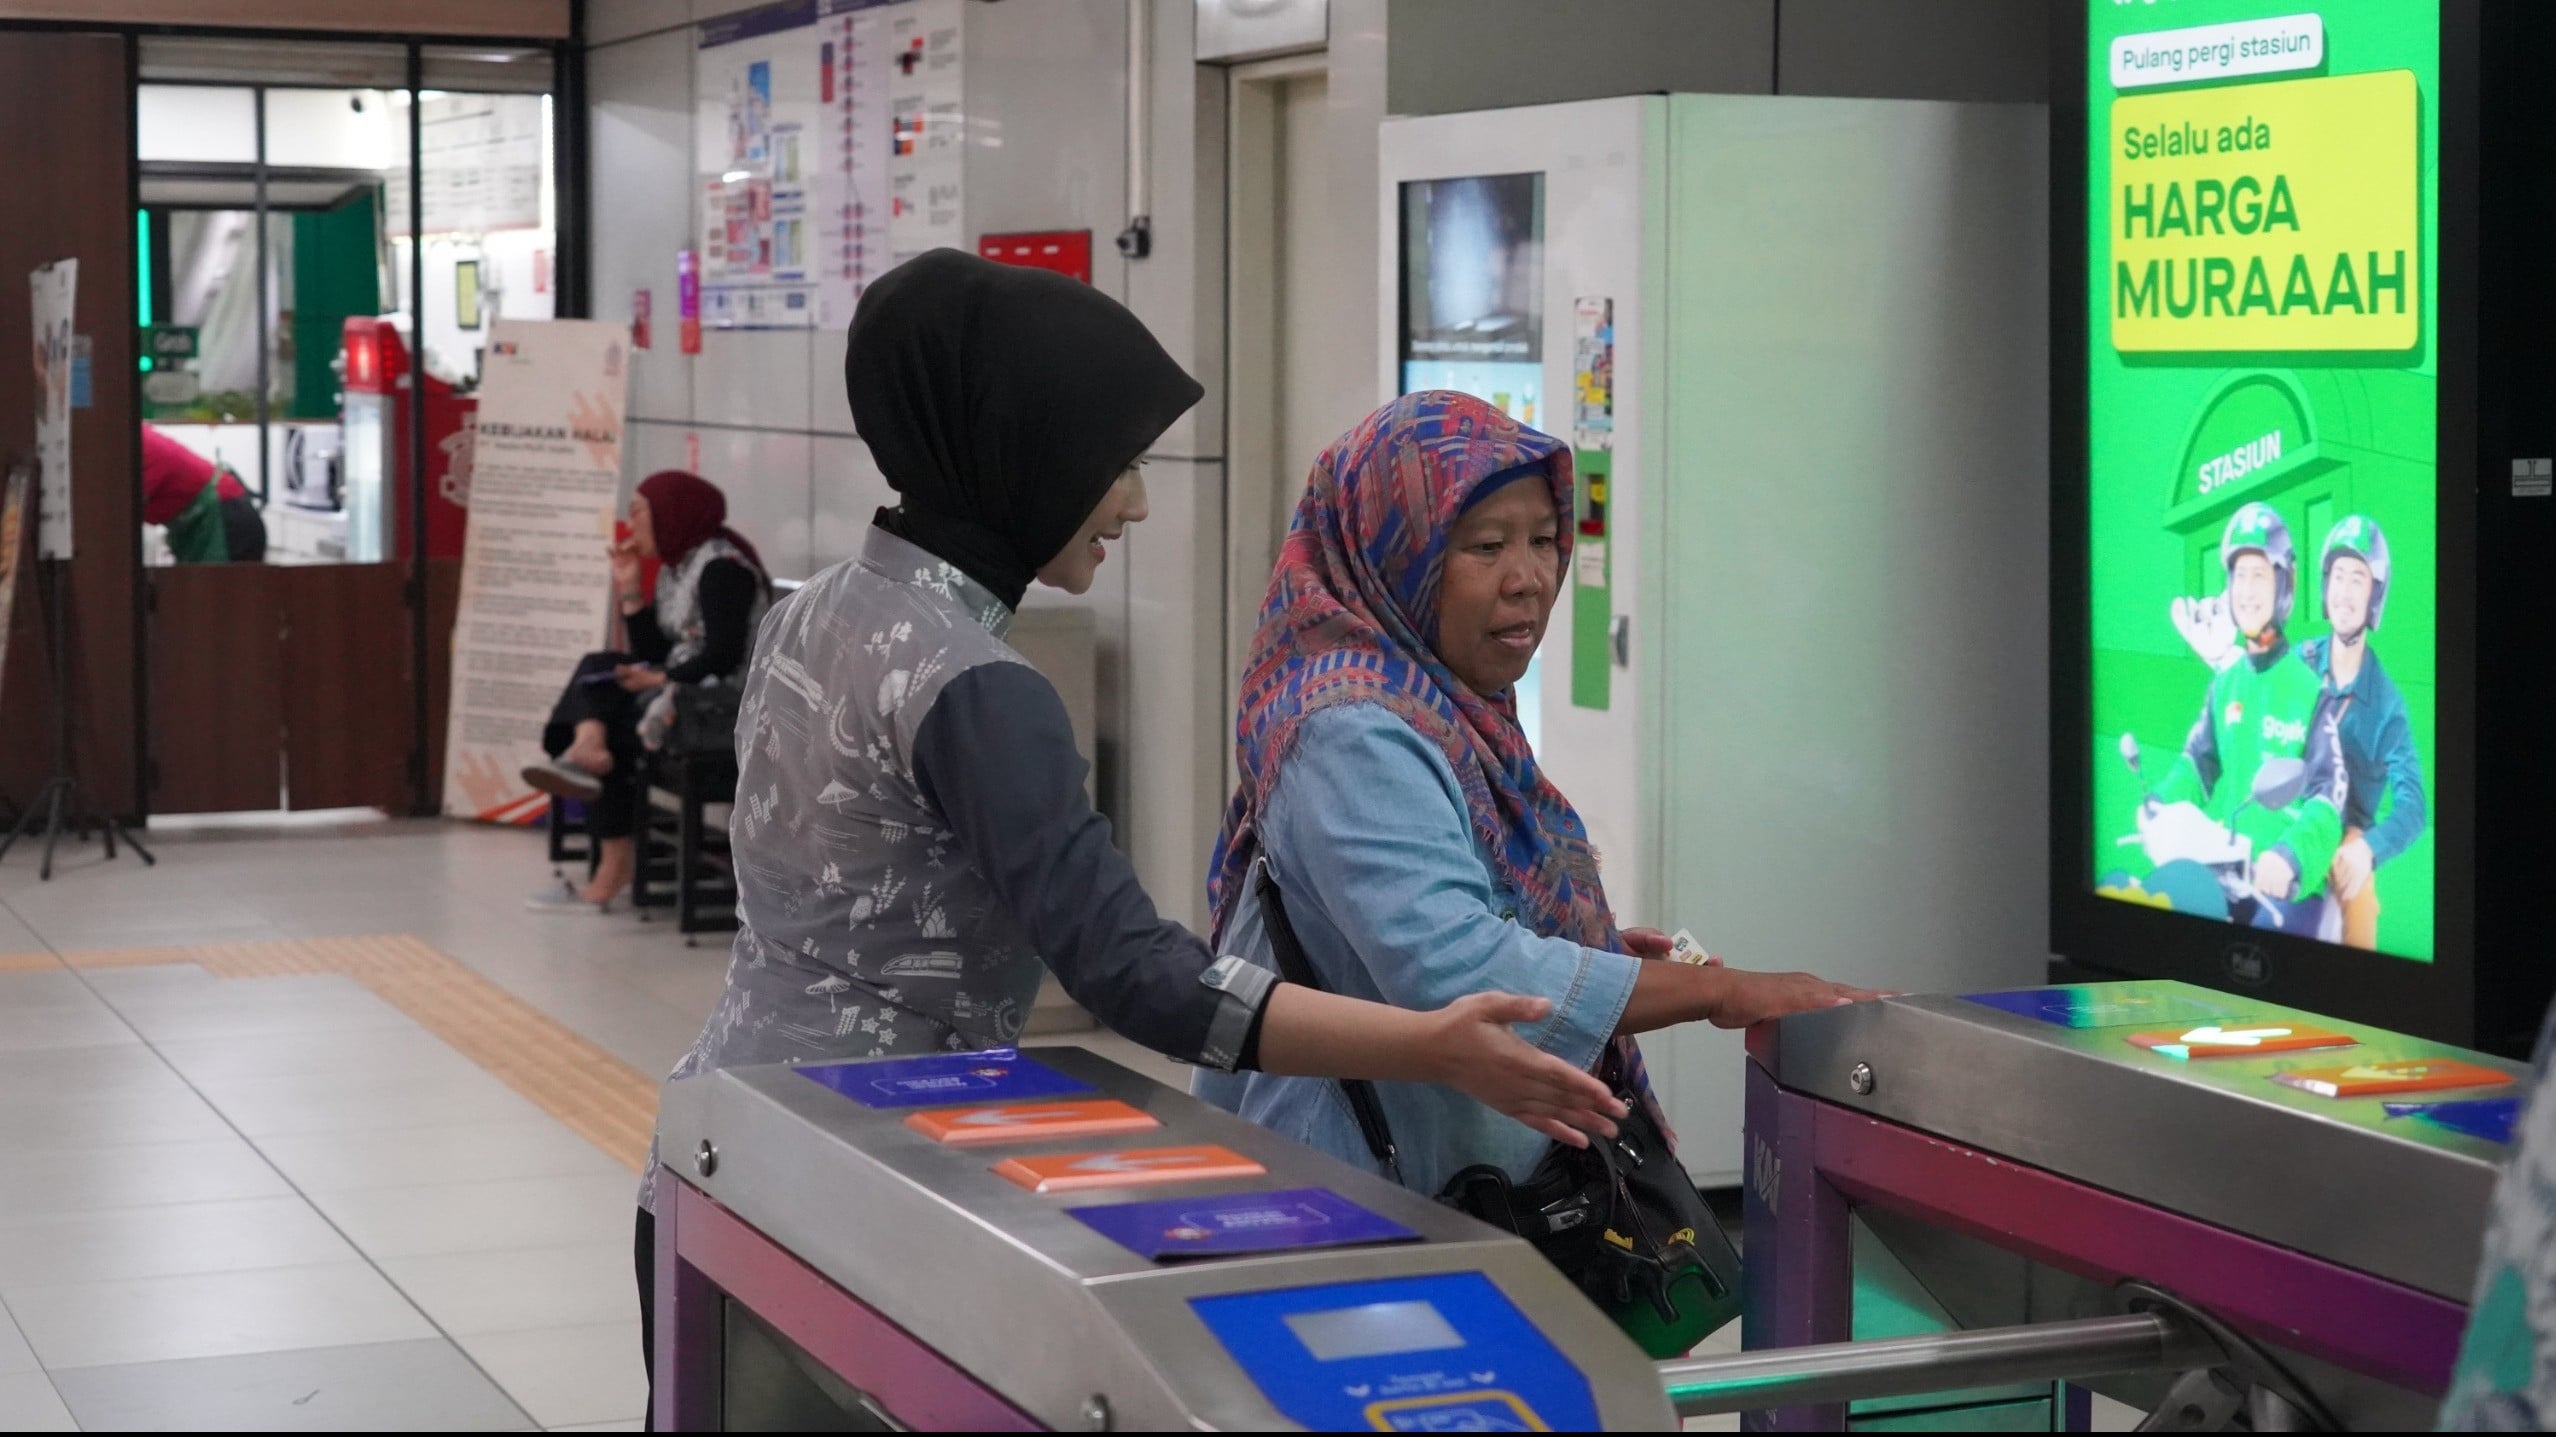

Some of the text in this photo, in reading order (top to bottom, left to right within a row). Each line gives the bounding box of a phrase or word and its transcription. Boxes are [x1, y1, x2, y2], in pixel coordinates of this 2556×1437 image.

[2123, 30, 2311, 72] Pulang pergi stasiun
[2124, 115, 2271, 160] Selalu ada
[2124, 174, 2300, 239] HARGA
[2117, 250, 2406, 319] MURAAAH
[2198, 429, 2281, 493] STASIUN
